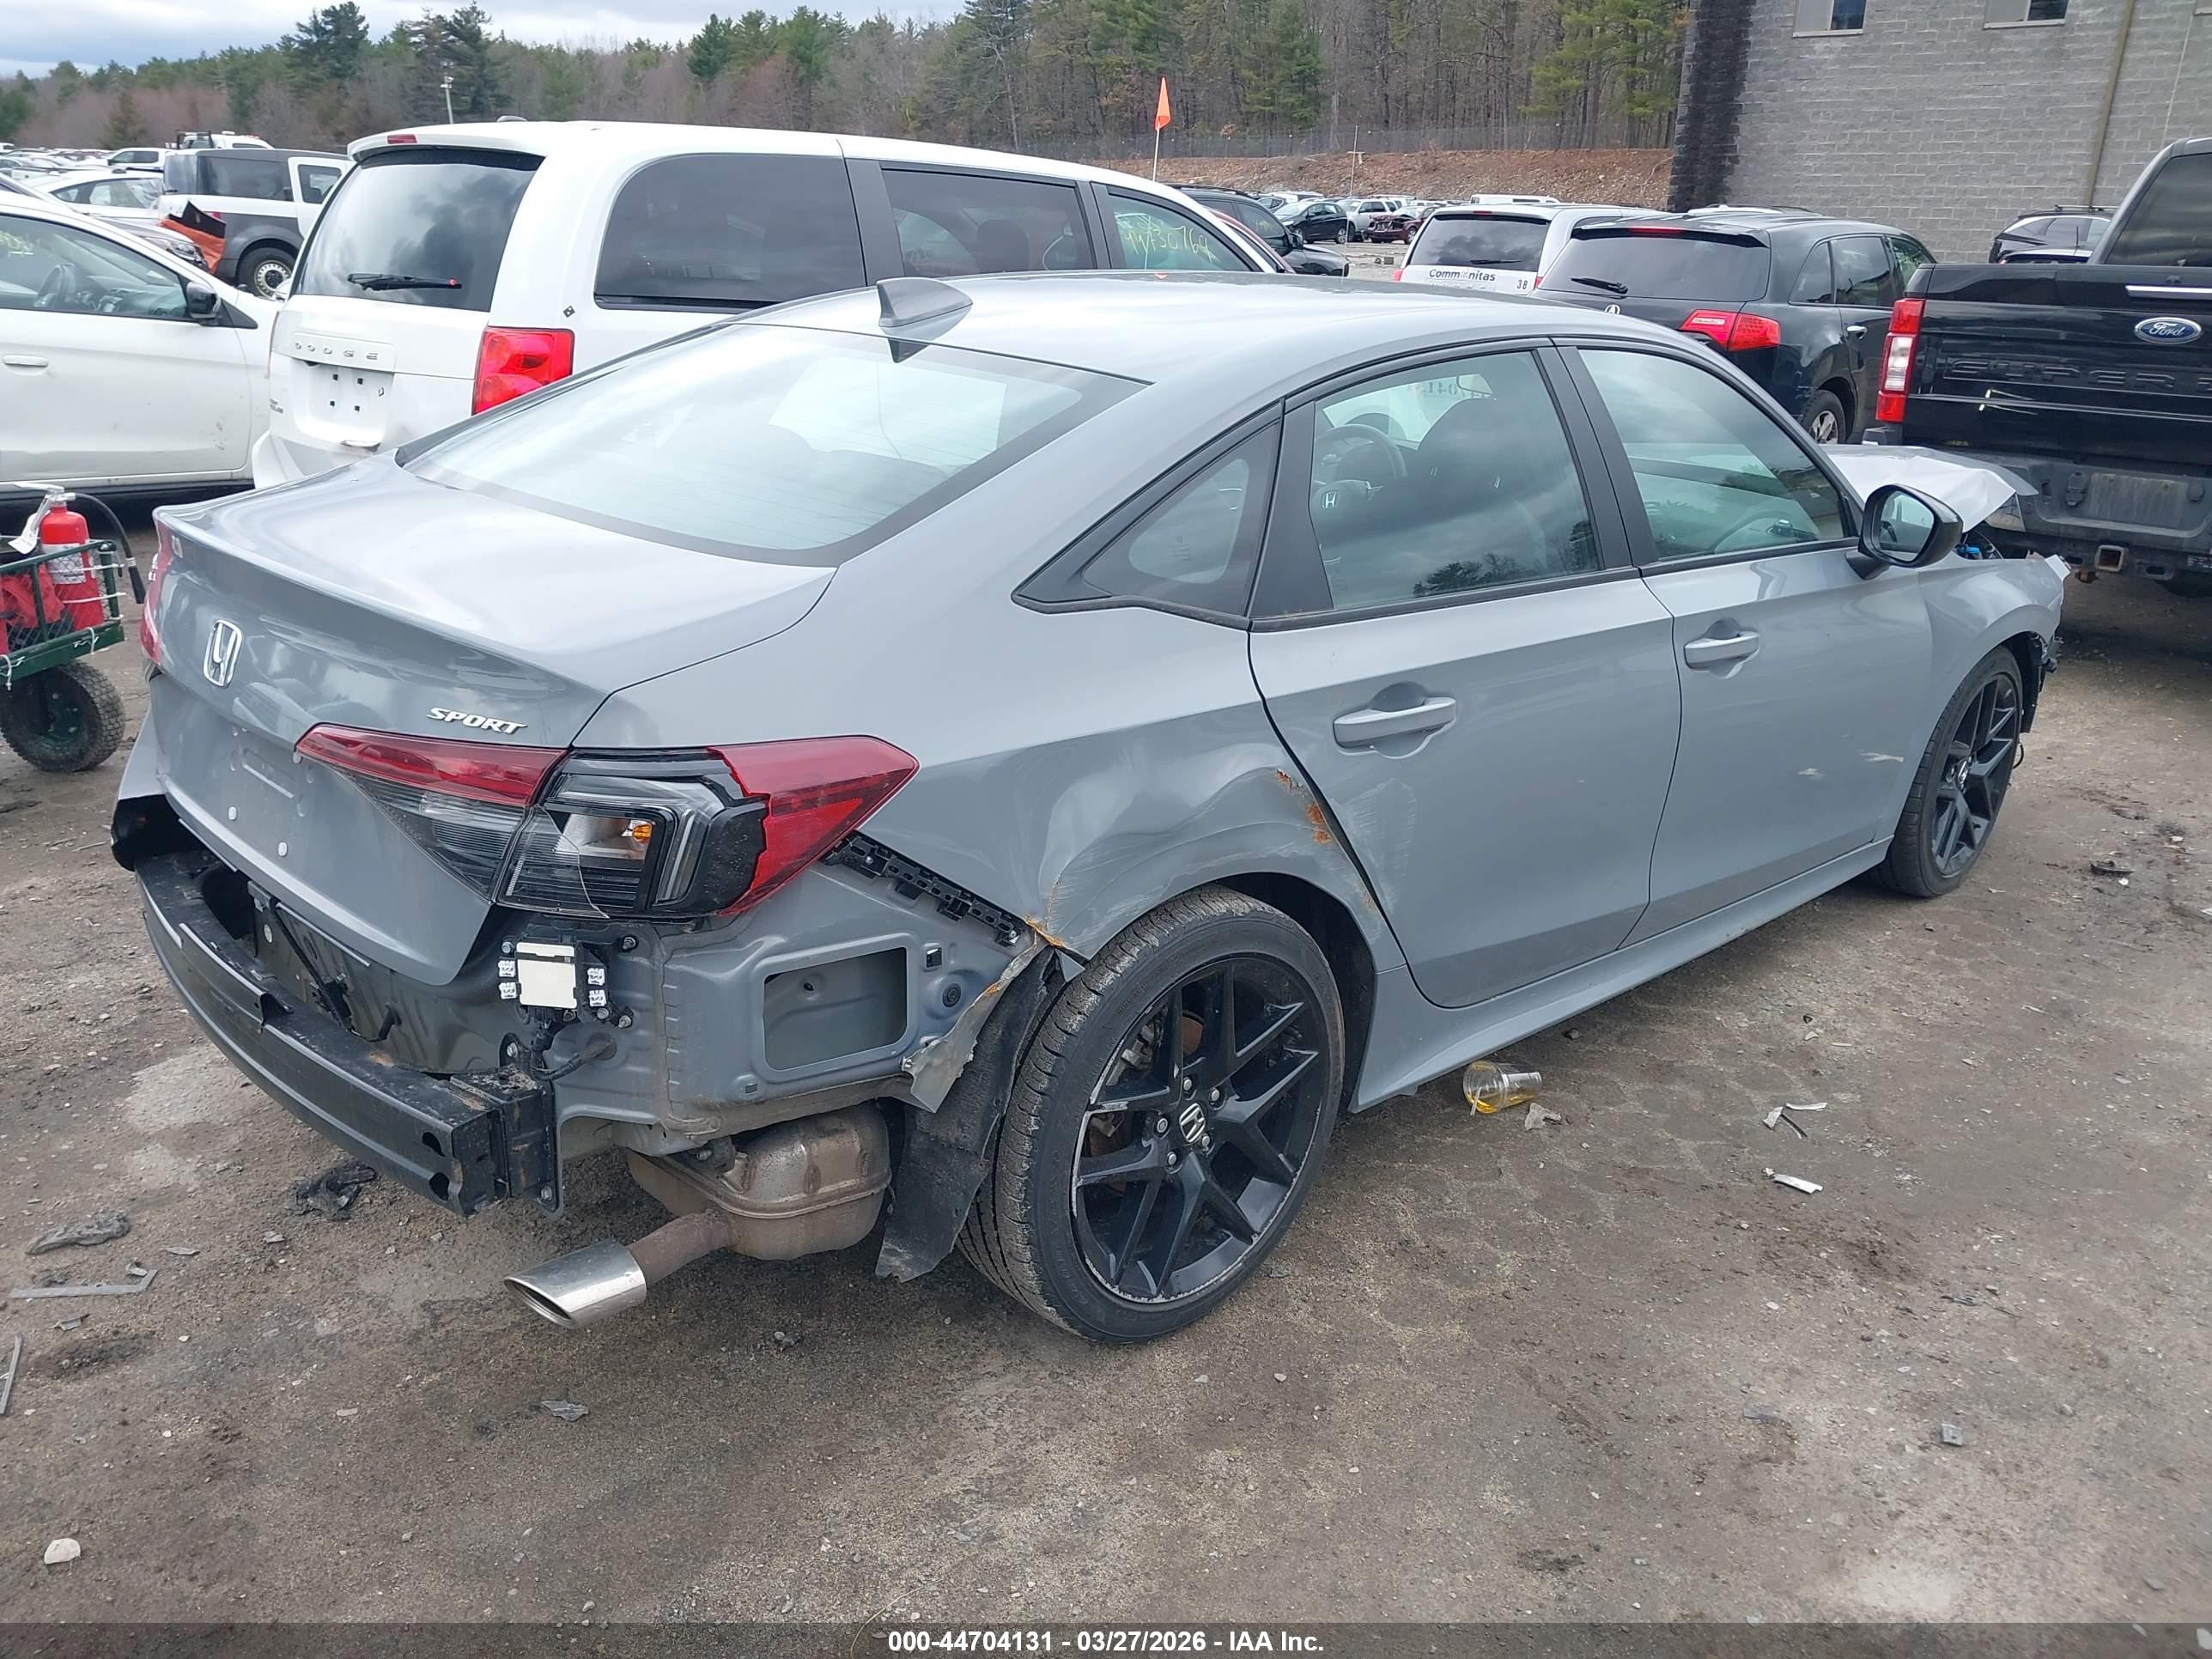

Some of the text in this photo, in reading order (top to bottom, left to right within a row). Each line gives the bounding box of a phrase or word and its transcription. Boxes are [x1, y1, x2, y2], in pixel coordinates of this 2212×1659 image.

[1516, 279, 1528, 290] 38
[2148, 321, 2186, 337] Ford
[295, 342, 379, 361] DODGE
[426, 707, 529, 735] SPORT
